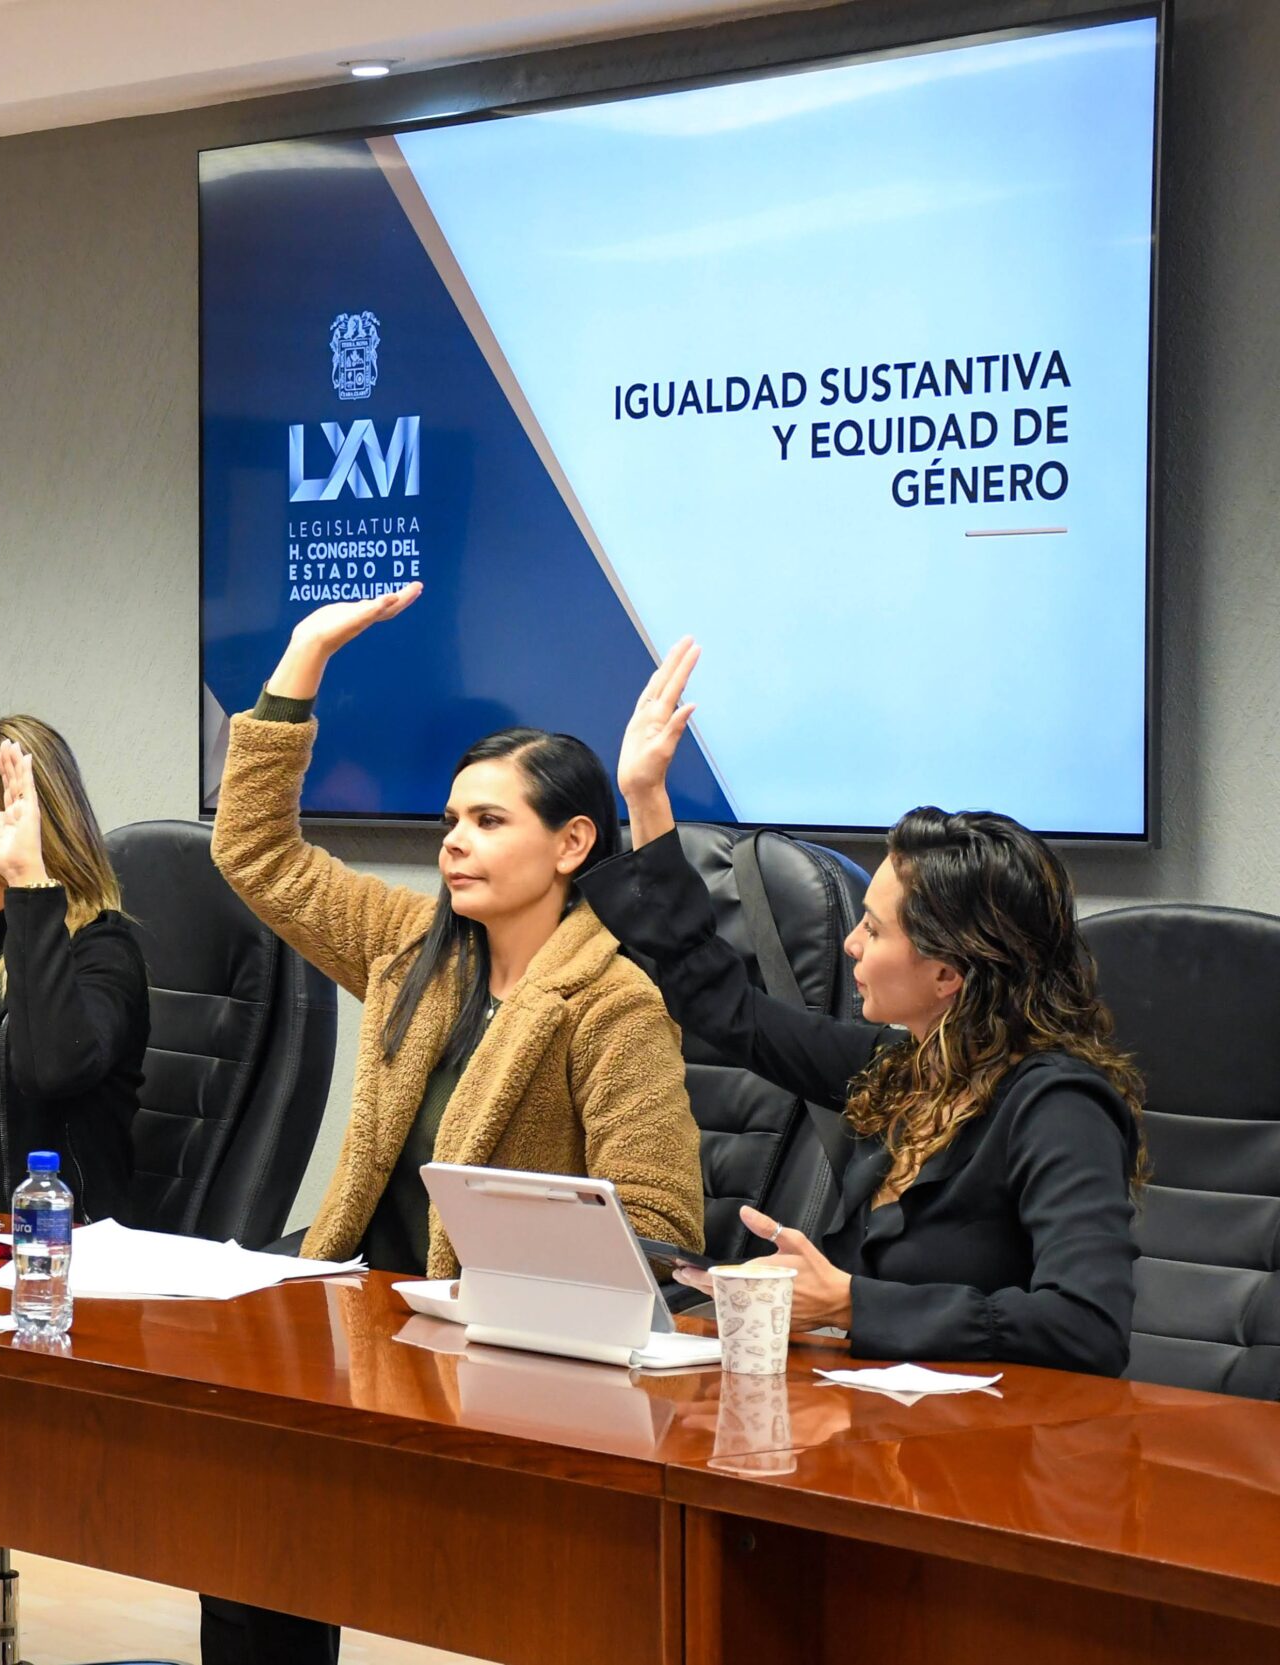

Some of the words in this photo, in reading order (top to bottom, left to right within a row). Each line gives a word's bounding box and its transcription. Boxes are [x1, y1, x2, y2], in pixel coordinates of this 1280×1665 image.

[615, 371, 807, 420] IGUALDAD
[820, 349, 1072, 406] SUSTANTIVA
[772, 423, 797, 461] Y
[810, 411, 998, 459] EQUIDAD
[1013, 405, 1069, 447] DE
[891, 458, 1069, 508] GÉNERO
[289, 516, 420, 538] LEGISLATURA
[289, 543, 303, 560] H.
[307, 540, 387, 560] CONGRESO
[391, 539, 420, 557] DEL
[289, 561, 376, 580] ESTADO
[393, 560, 420, 577] DE
